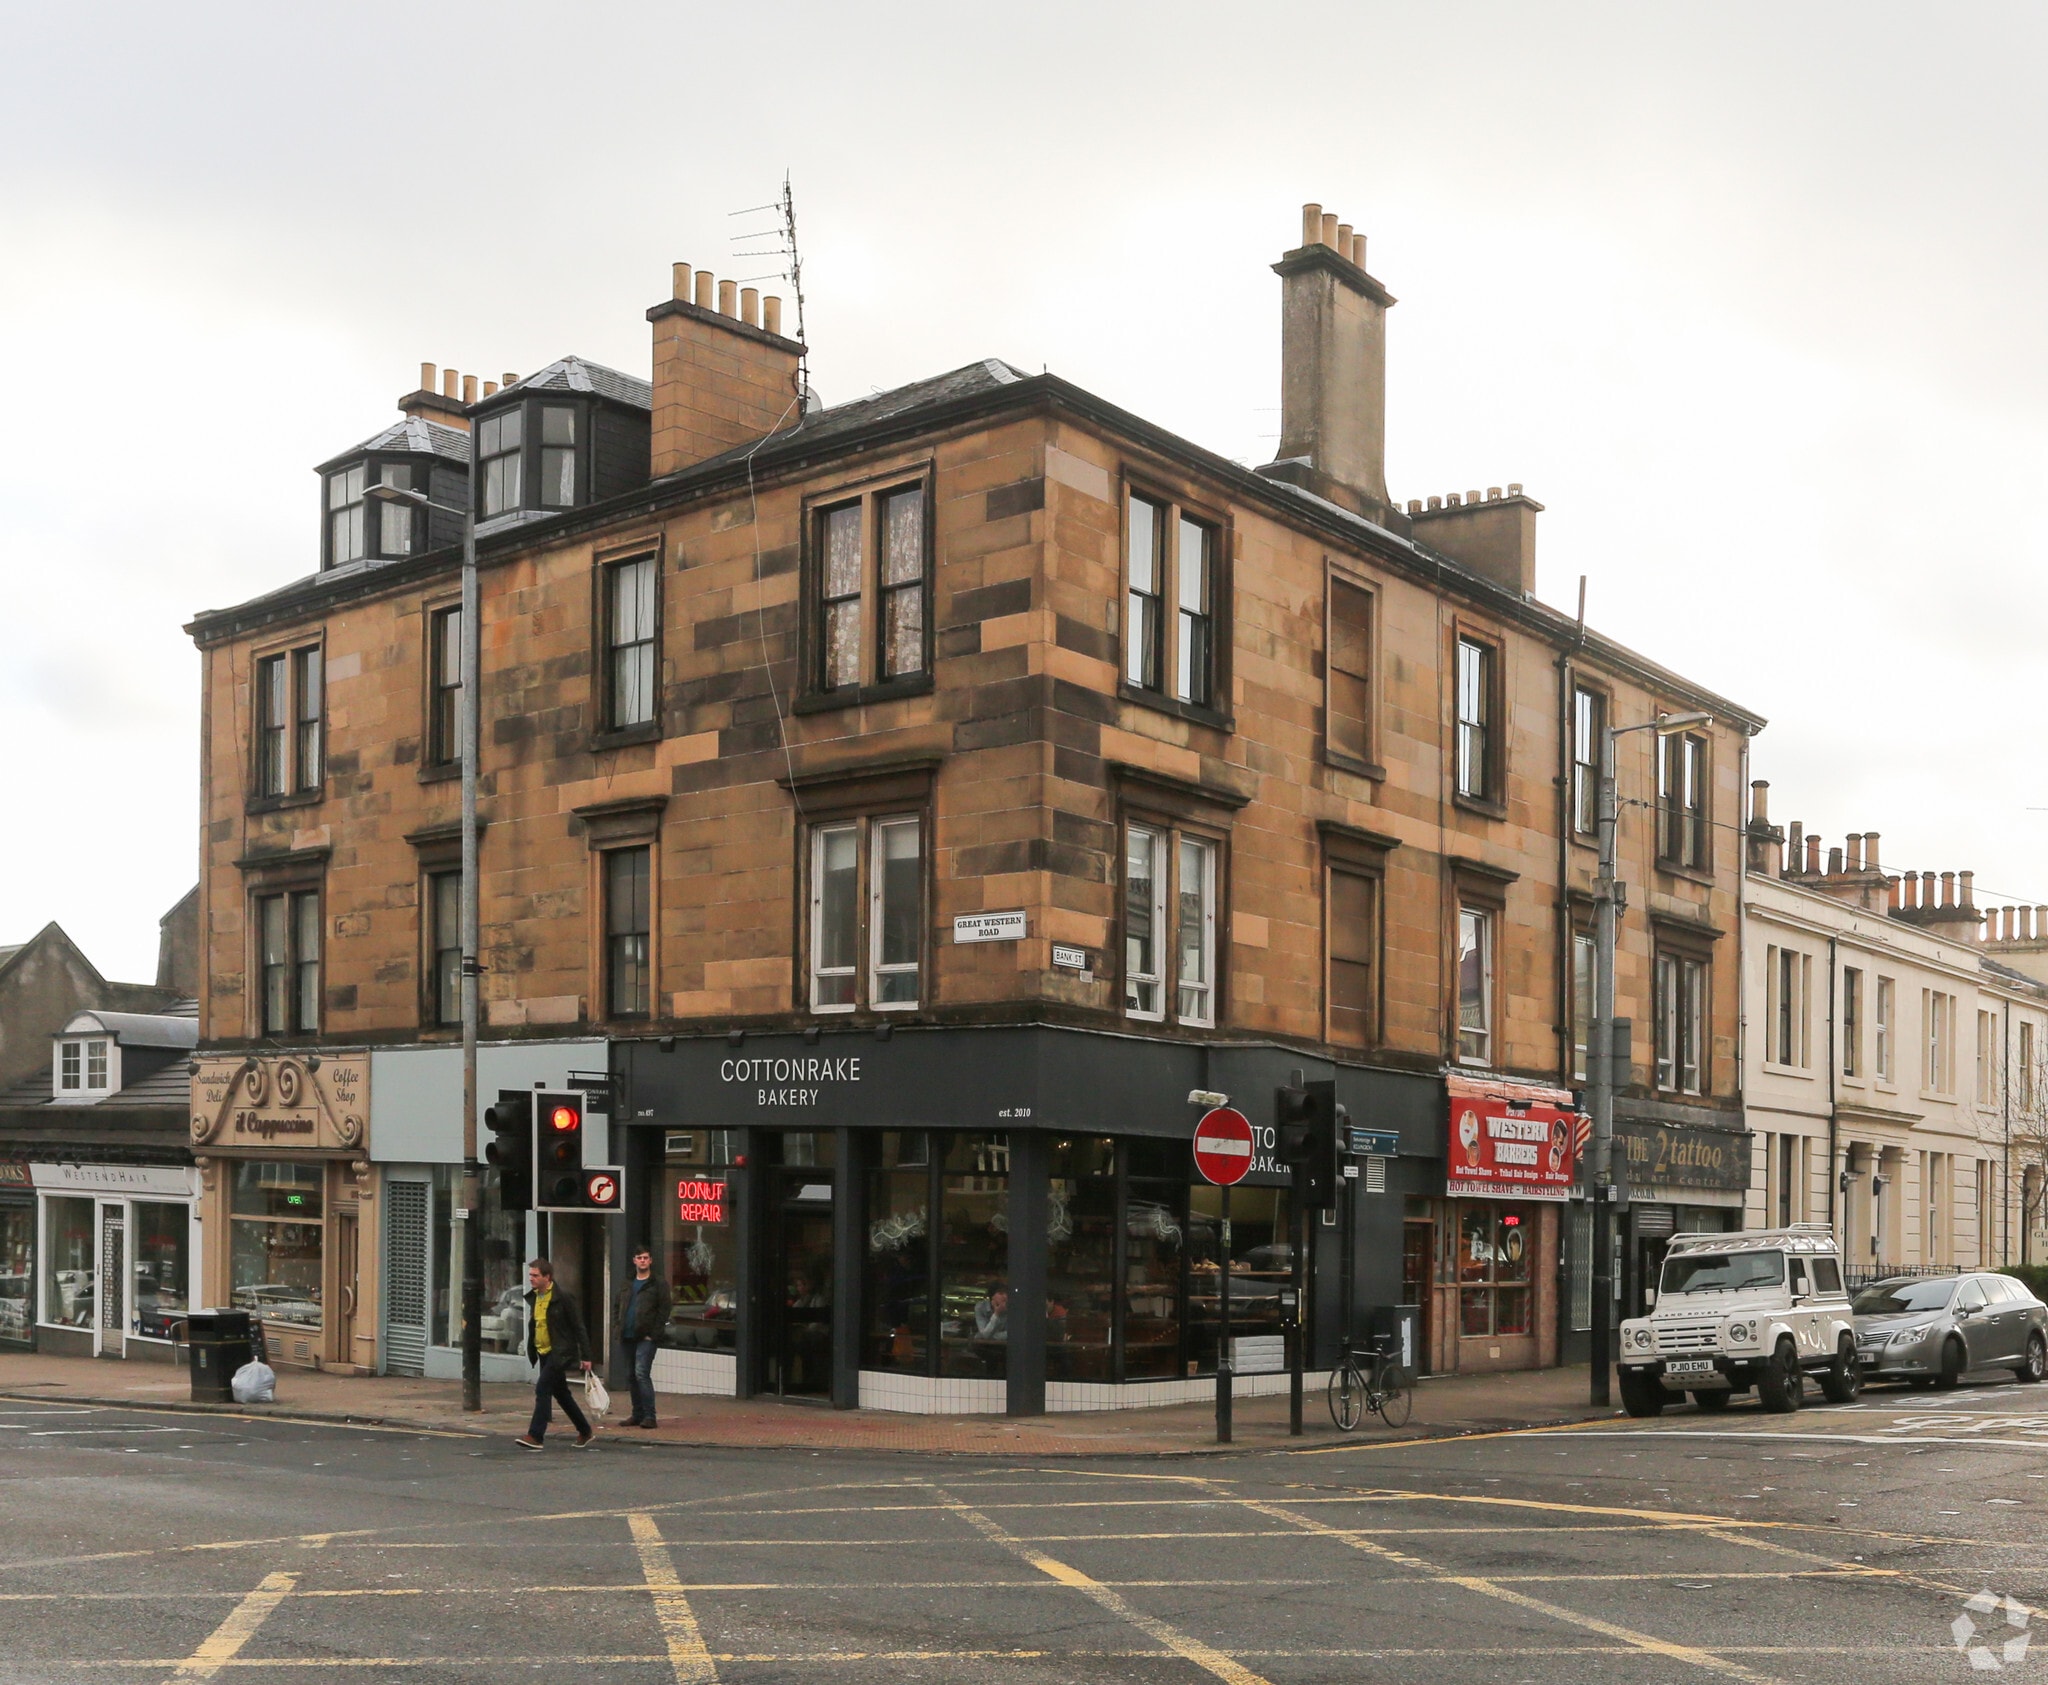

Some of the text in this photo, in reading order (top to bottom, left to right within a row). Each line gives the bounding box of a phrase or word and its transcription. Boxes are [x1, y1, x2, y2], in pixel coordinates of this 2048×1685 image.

[957, 916, 1022, 929] GREAT WESTERN
[978, 928, 1000, 937] ROAD
[1056, 951, 1072, 961] BANK
[333, 1068, 359, 1087] Coffee
[720, 1057, 861, 1082] COTTONRAKE
[206, 1089, 222, 1103] Deli
[335, 1088, 356, 1106] Shop
[758, 1089, 819, 1106] BAKERY
[998, 1108, 1031, 1118] est. 2010
[235, 1111, 314, 1139] il Cappuccino
[1486, 1117, 1549, 1142] WESTERN
[1494, 1142, 1538, 1165] BARBERS
[1654, 1130, 1668, 1173] 2
[1670, 1136, 1722, 1169] tattoo
[1449, 1180, 1464, 1192] HOT
[1466, 1182, 1490, 1193] TOWEL
[1491, 1184, 1514, 1195] SHAVE
[1522, 1185, 1565, 1196] HAIRSTYLING
[1679, 1177, 1721, 1185] centre
[678, 1181, 726, 1200] DONUT
[681, 1203, 721, 1222] REPAIR
[1671, 1362, 1709, 1372] PJ10 EHU
